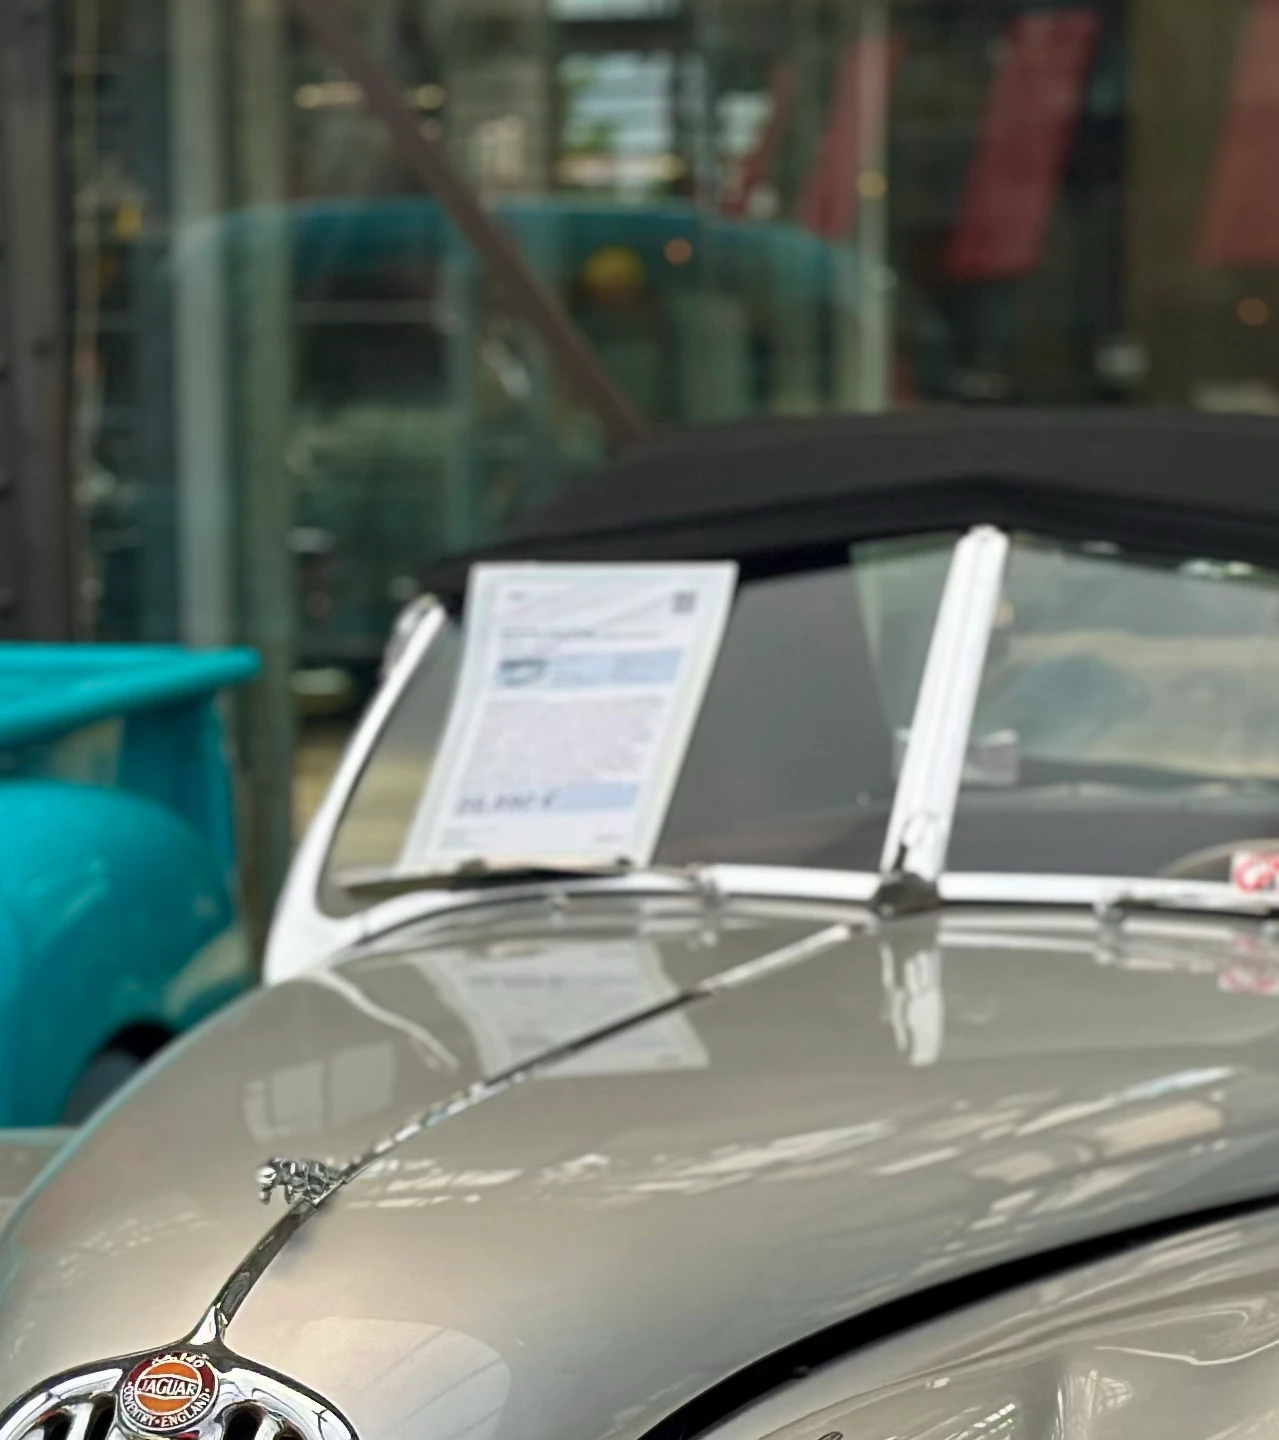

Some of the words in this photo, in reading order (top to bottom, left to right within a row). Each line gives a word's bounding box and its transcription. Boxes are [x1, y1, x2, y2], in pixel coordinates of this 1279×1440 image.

[138, 1377, 198, 1397] JAGUAR
[122, 1385, 158, 1427] COVENTRY
[160, 1391, 211, 1428] ENGLAND
